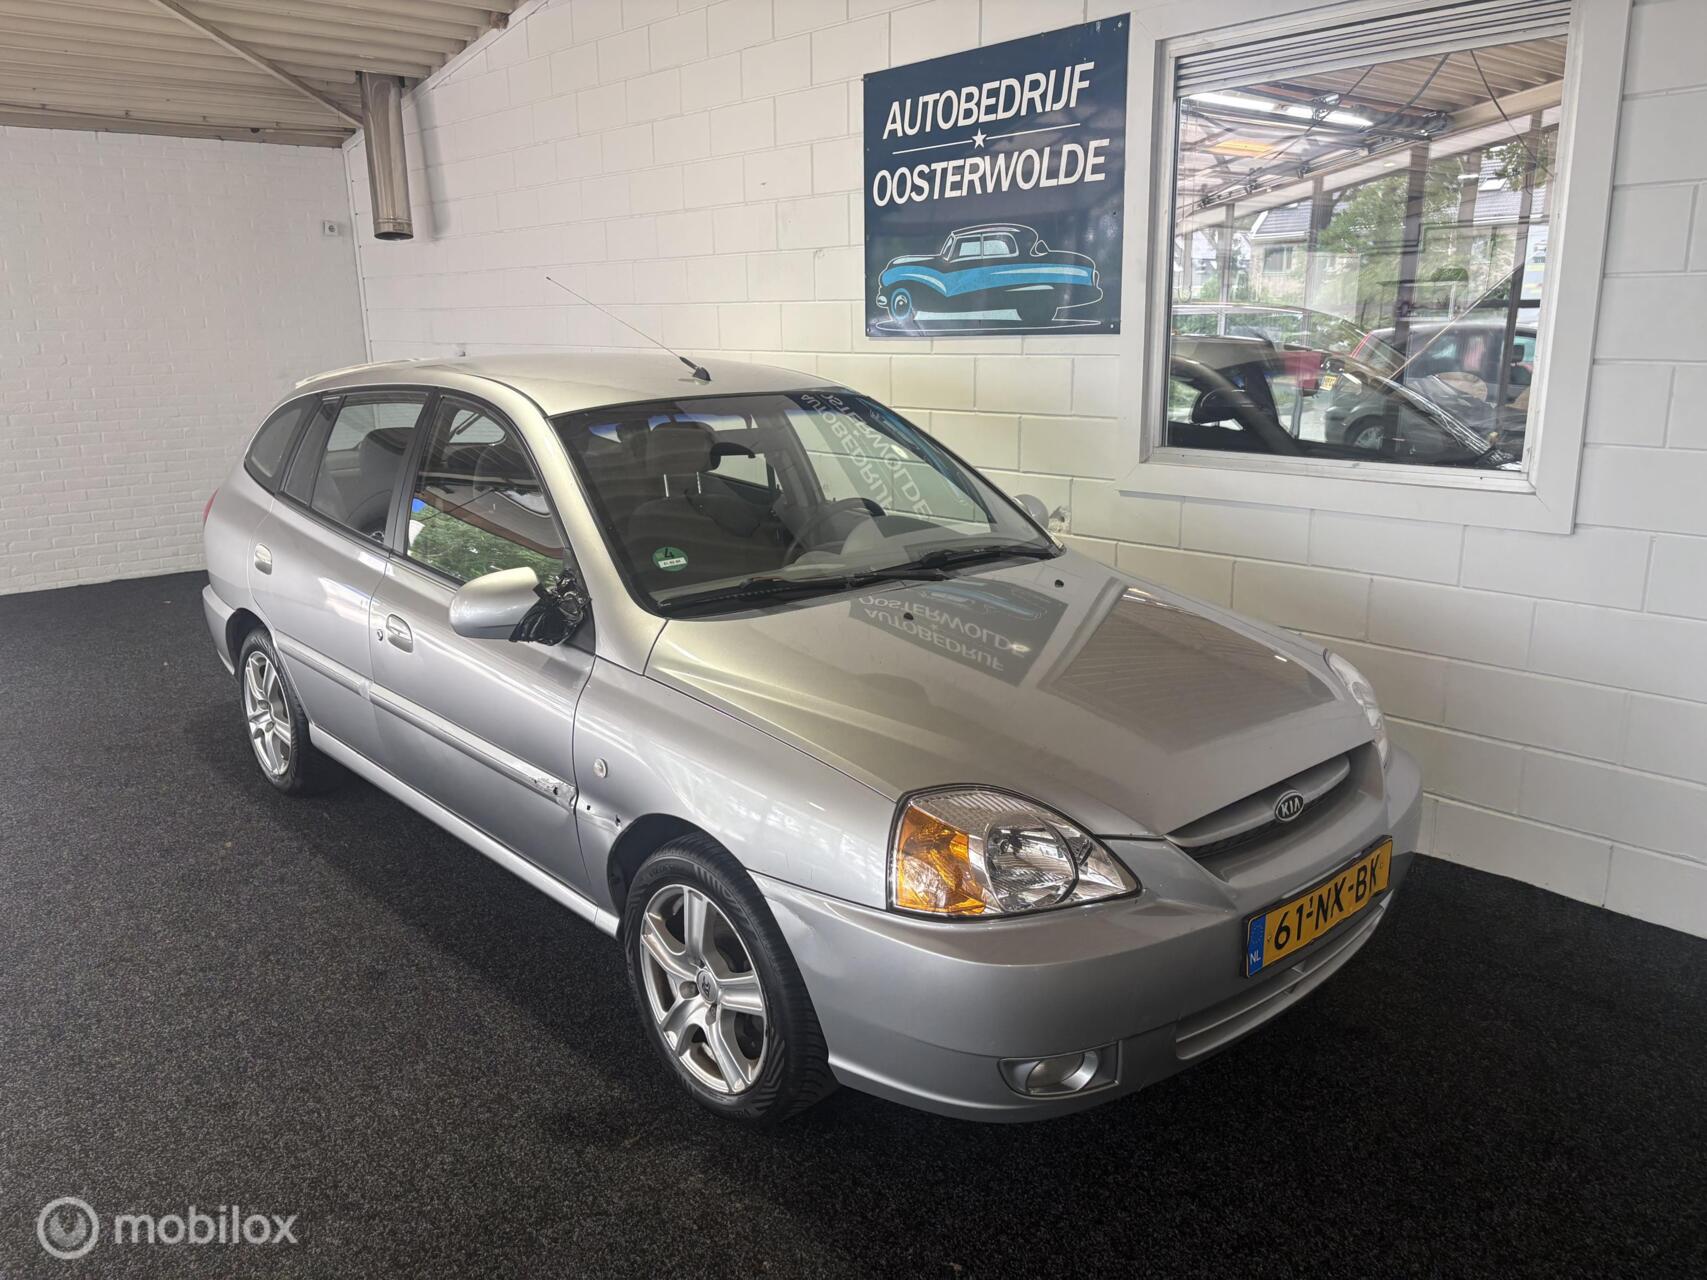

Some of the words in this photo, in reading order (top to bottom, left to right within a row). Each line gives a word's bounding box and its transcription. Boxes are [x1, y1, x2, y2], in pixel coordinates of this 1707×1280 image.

[883, 61, 1095, 139] AUTOBEDRIJF
[872, 138, 1110, 207] OOSTERWOLDE
[1280, 797, 1301, 817] KIA
[1274, 853, 1380, 950] 61-NX-BK
[1249, 949, 1261, 965] NL
